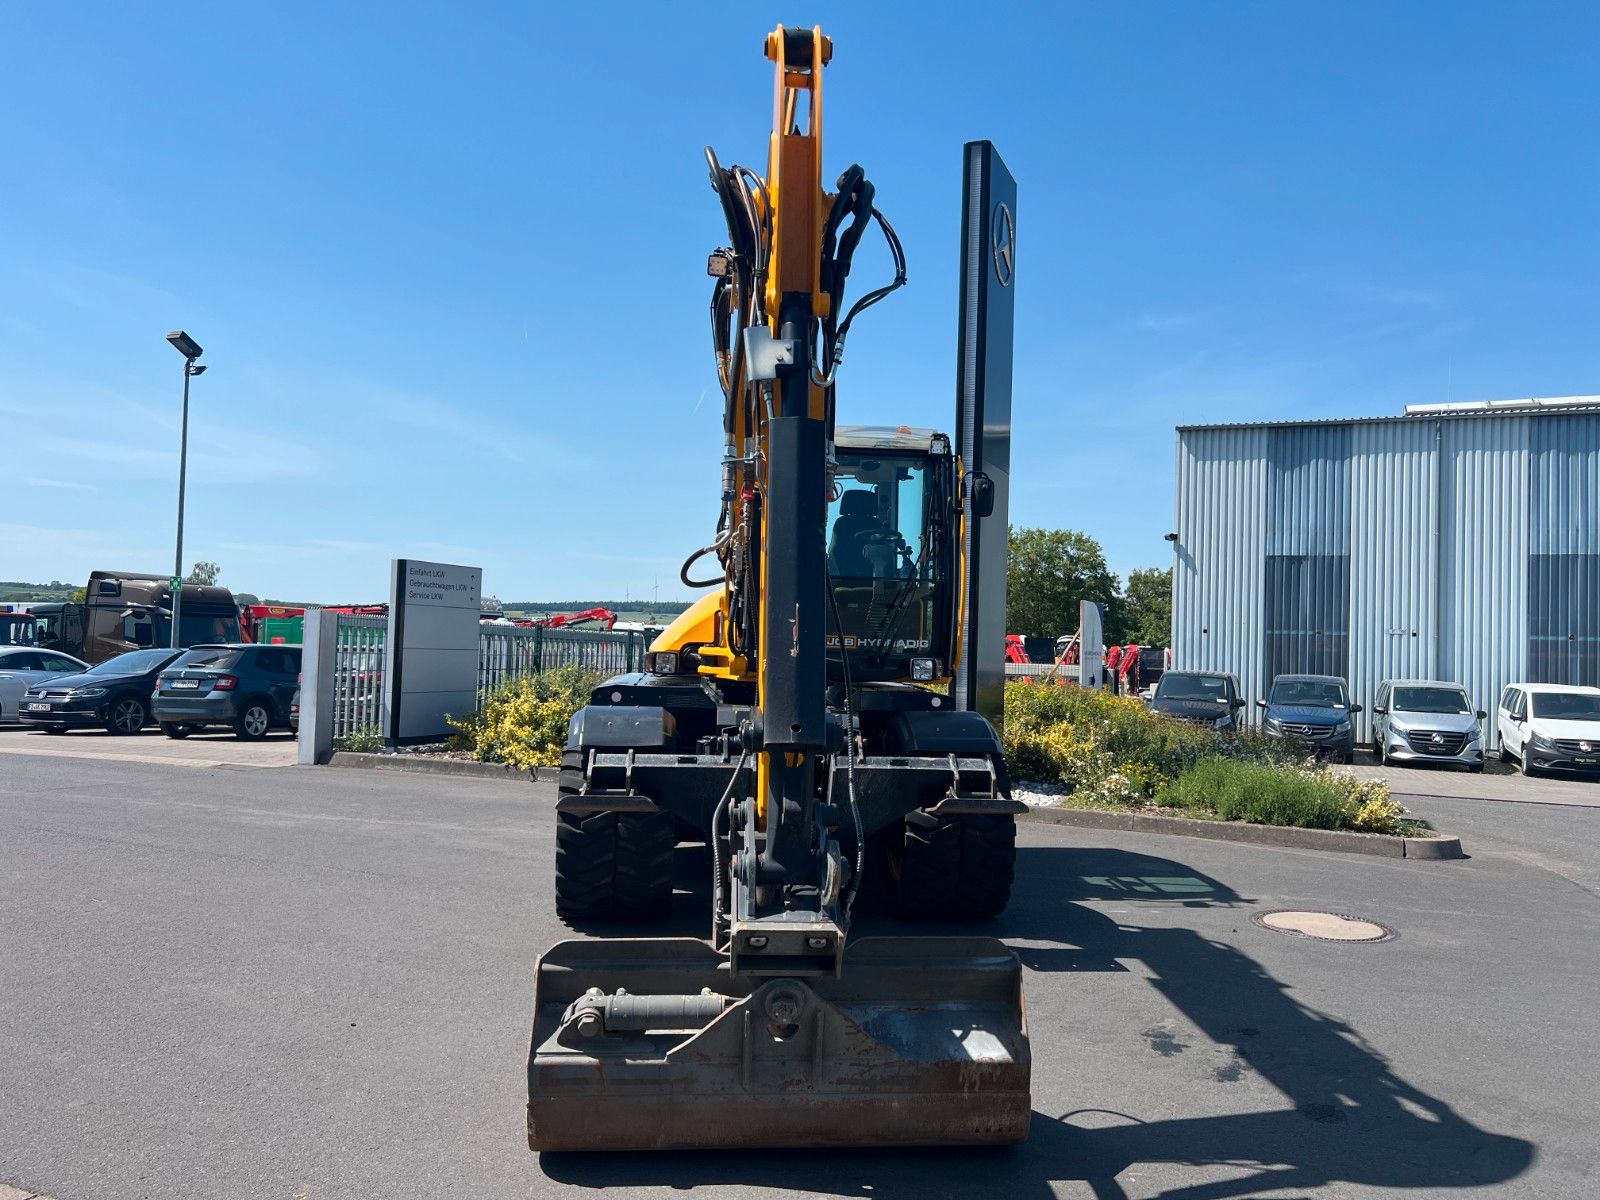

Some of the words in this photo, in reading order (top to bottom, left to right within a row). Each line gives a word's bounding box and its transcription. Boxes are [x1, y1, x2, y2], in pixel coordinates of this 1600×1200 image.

[409, 567, 431, 577] Einfahrt
[432, 570, 445, 578] LKW
[409, 579, 454, 591] Gebrauchtwagen
[455, 583, 467, 592] LKW
[409, 590, 430, 599] Service
[431, 592, 444, 600] LKW
